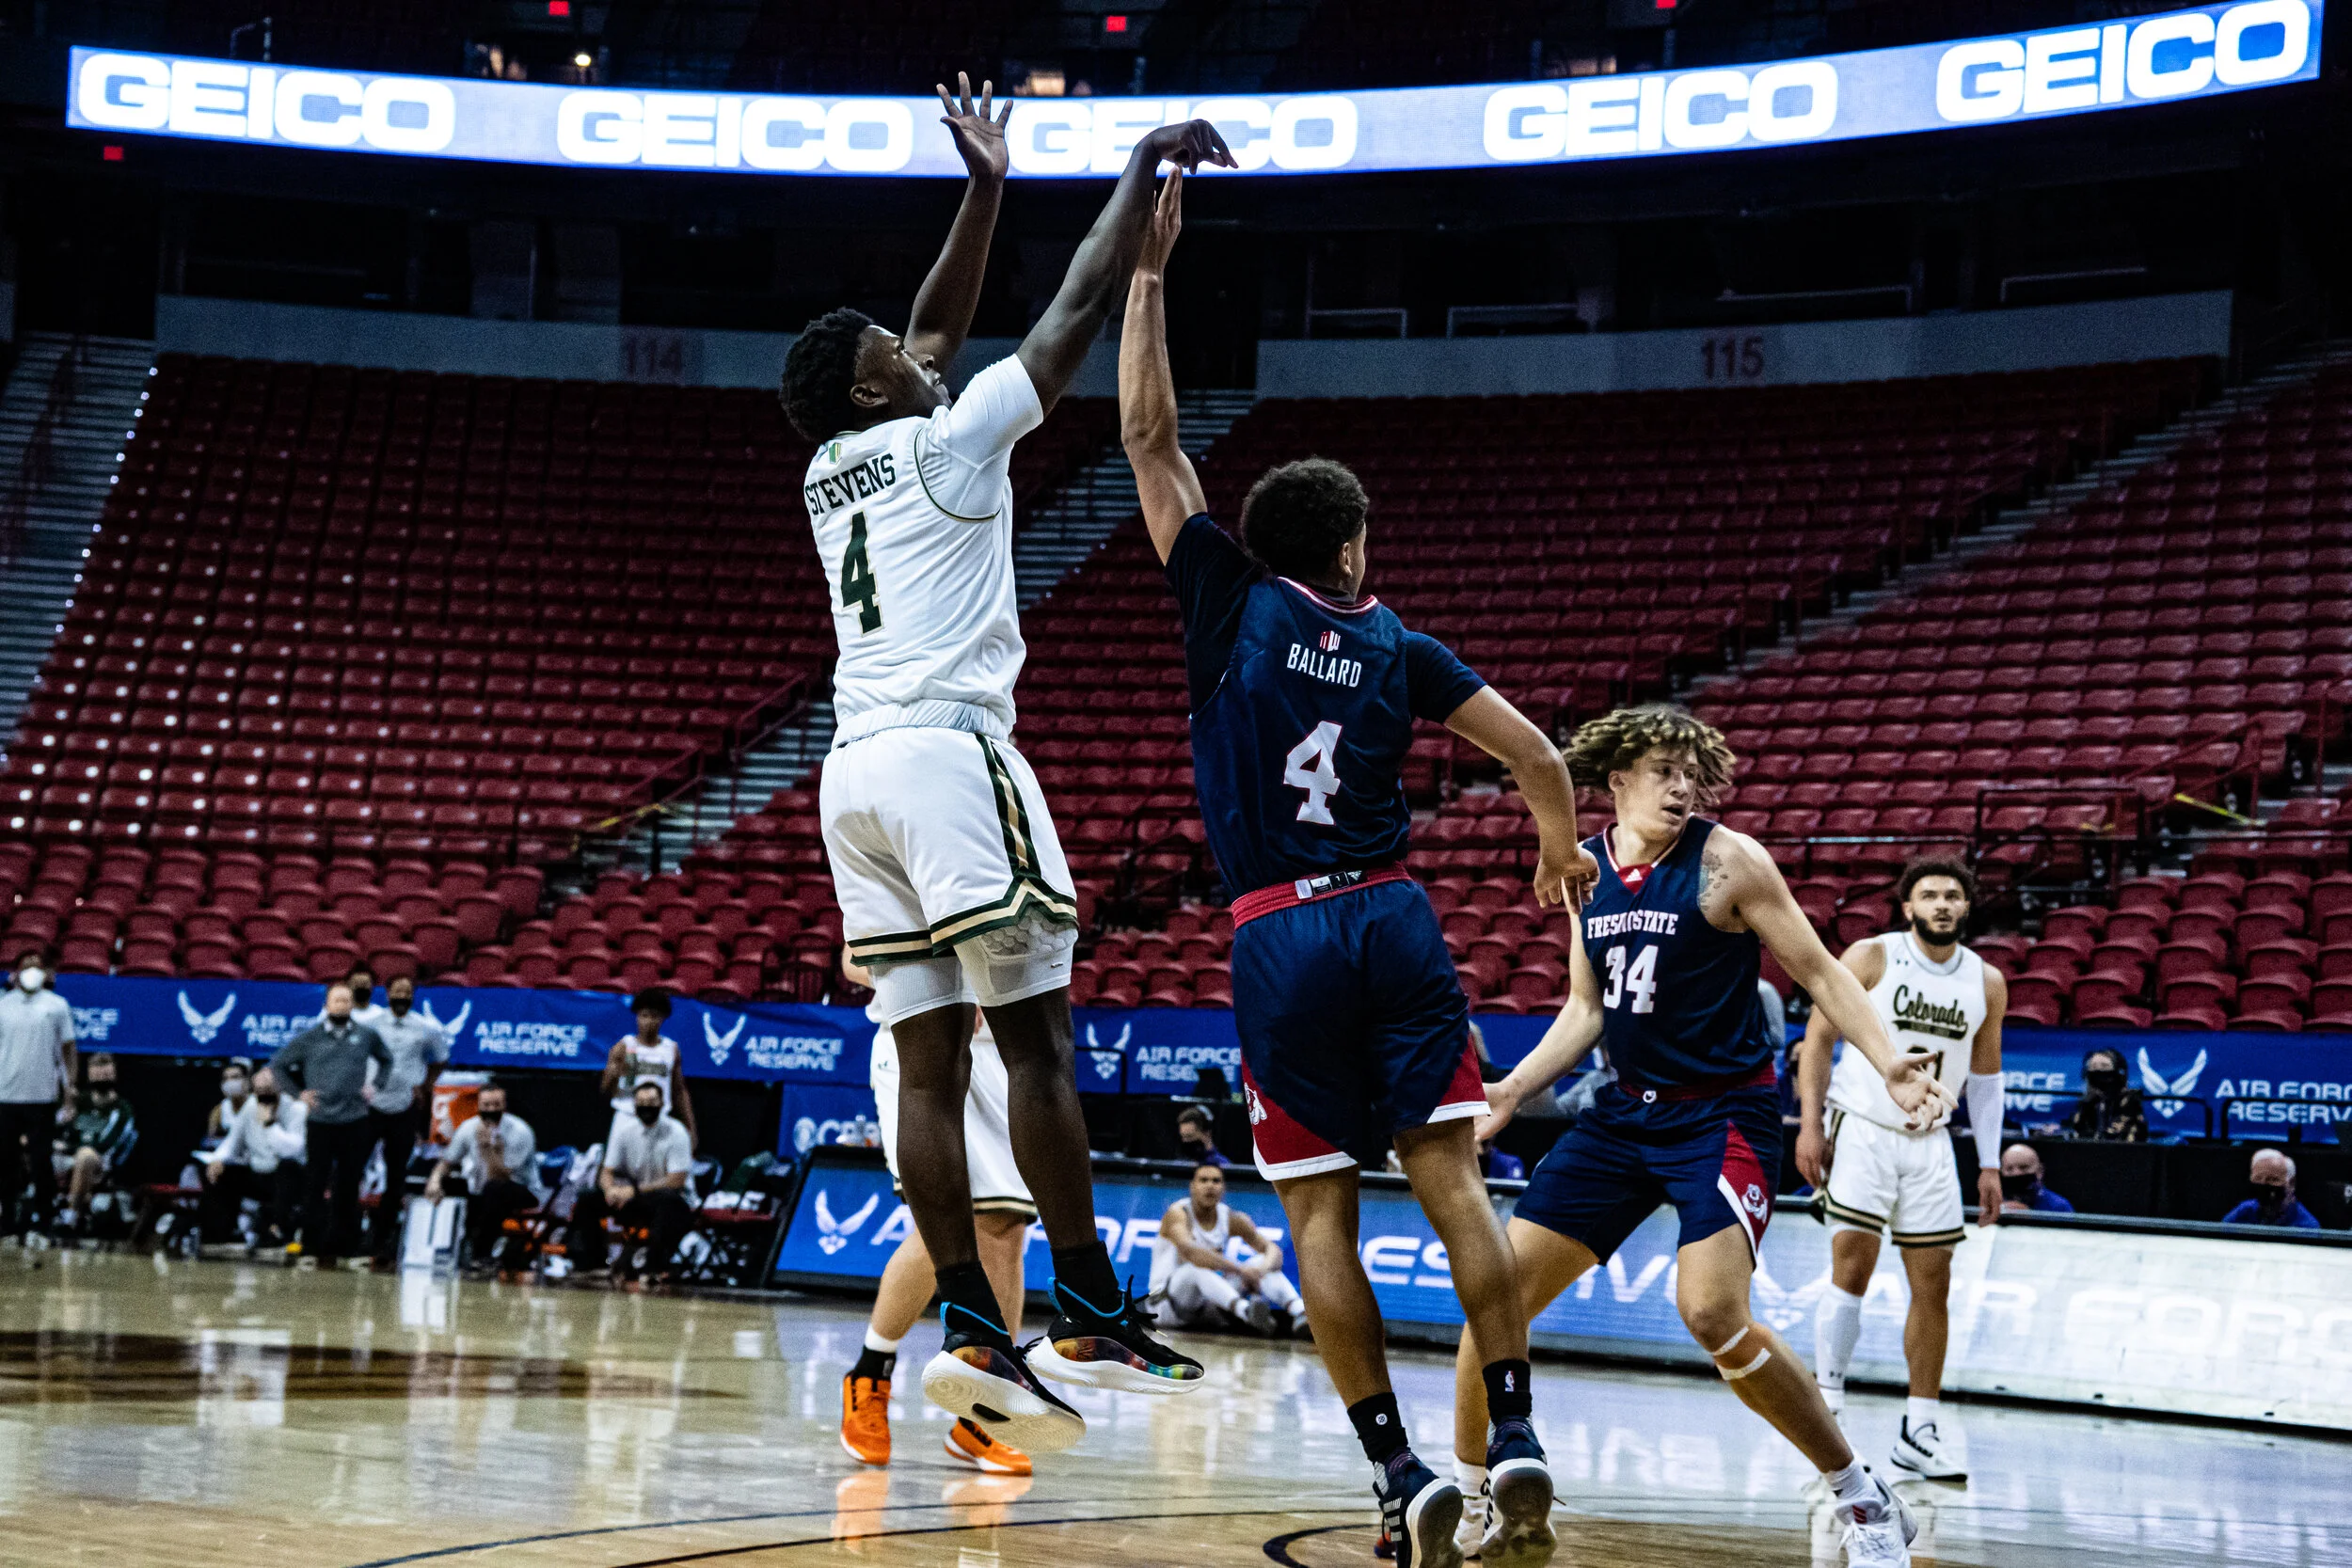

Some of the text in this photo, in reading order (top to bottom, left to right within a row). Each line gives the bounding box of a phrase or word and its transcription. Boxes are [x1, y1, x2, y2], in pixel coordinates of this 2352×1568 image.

[1936, 0, 2311, 123] GEICO
[78, 53, 455, 152] GEICO
[1484, 60, 1839, 162] GEICO
[557, 91, 914, 172] GEICO
[620, 337, 683, 377] 114
[1700, 335, 1765, 378] 115
[804, 452, 897, 516] STEVENS
[840, 509, 883, 638] 4
[1286, 642, 1362, 688] BALLARD
[1283, 720, 1343, 826] 4
[1633, 909, 1679, 936] STATE
[1602, 944, 1659, 1014] 34
[1893, 984, 1966, 1028] Colorado
[474, 1022, 587, 1042] AIR FORCE
[479, 1037, 580, 1057] RESERVE
[744, 1036, 843, 1055] AIR FORCE
[748, 1053, 835, 1071] RESERVE
[1136, 1045, 1242, 1066] AIR FORCE
[2216, 1079, 2271, 1099] AIR
